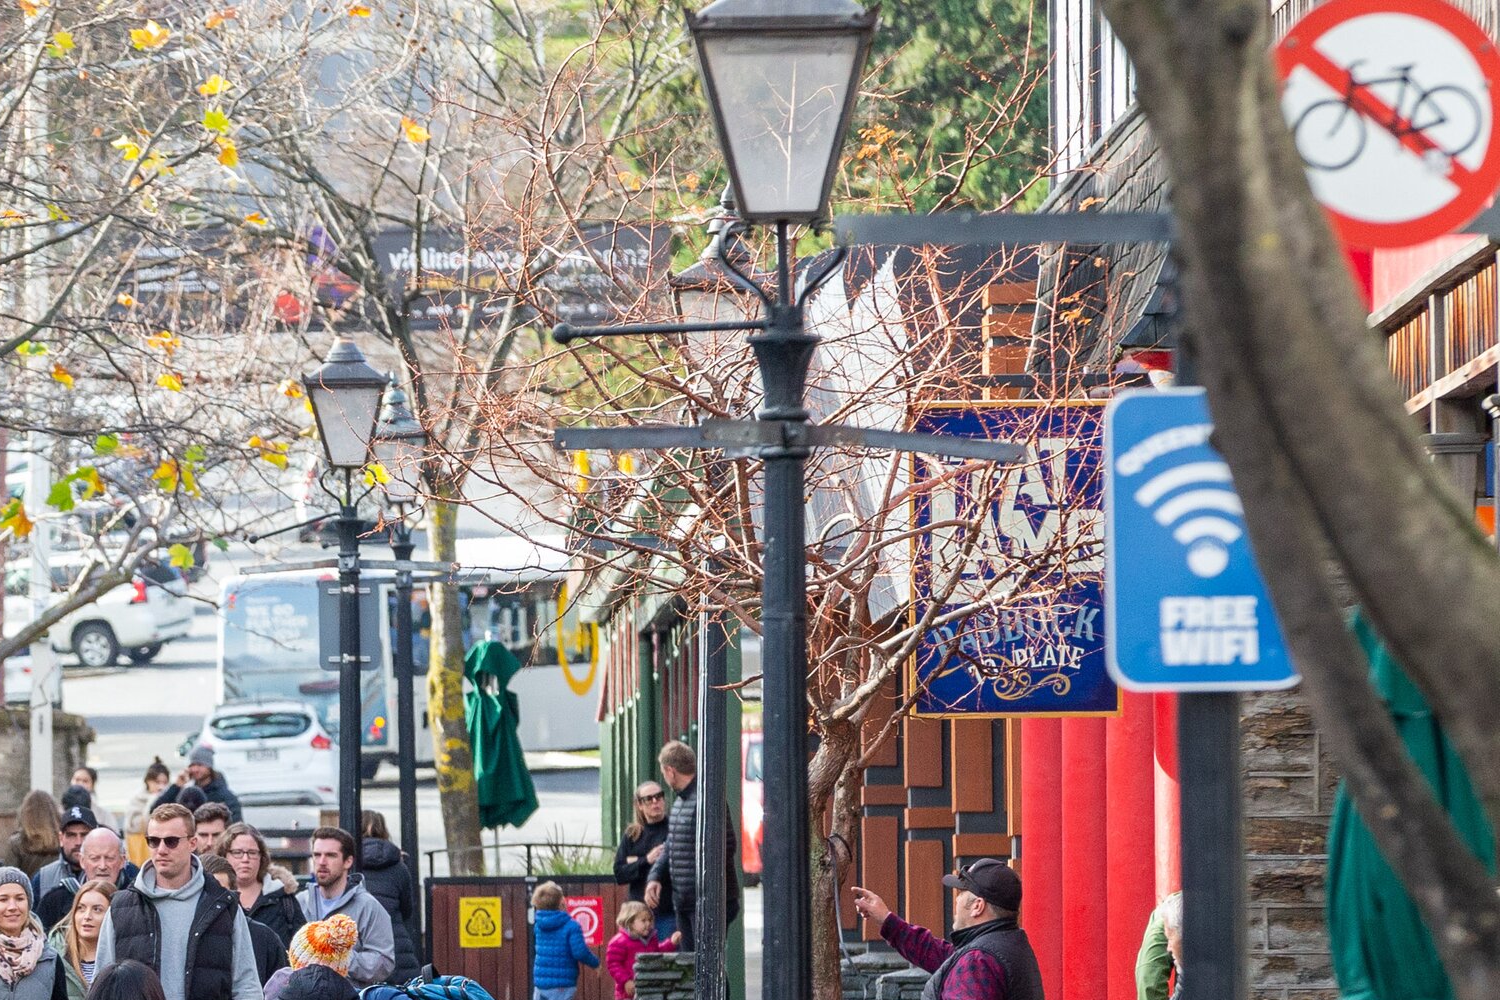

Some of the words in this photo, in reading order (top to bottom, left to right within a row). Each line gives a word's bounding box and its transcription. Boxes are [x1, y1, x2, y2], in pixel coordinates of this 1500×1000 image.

[1160, 595, 1257, 628] FREE
[1014, 644, 1085, 670] PLATE
[1161, 629, 1260, 667] WIFI
